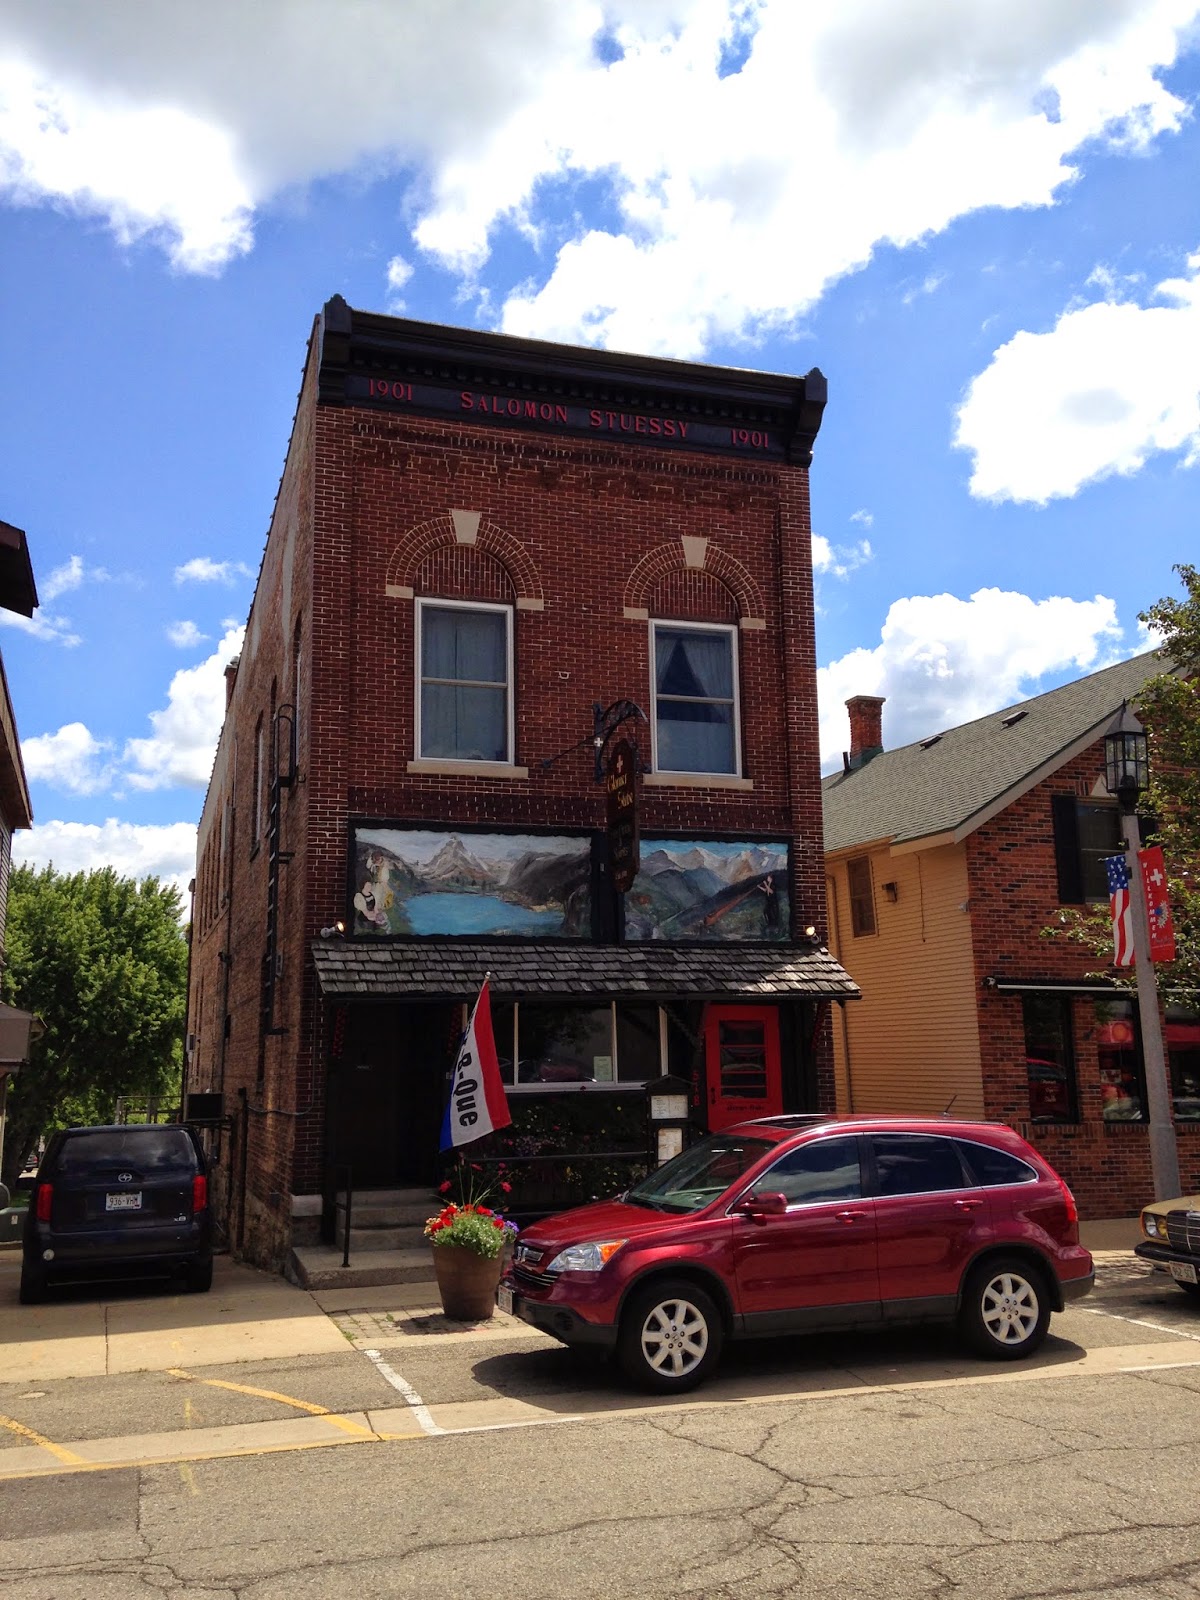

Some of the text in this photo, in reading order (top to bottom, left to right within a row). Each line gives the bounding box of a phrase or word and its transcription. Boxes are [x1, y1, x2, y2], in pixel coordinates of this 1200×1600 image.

[368, 378, 770, 448] 1901 SALOMON STUESSY 1901
